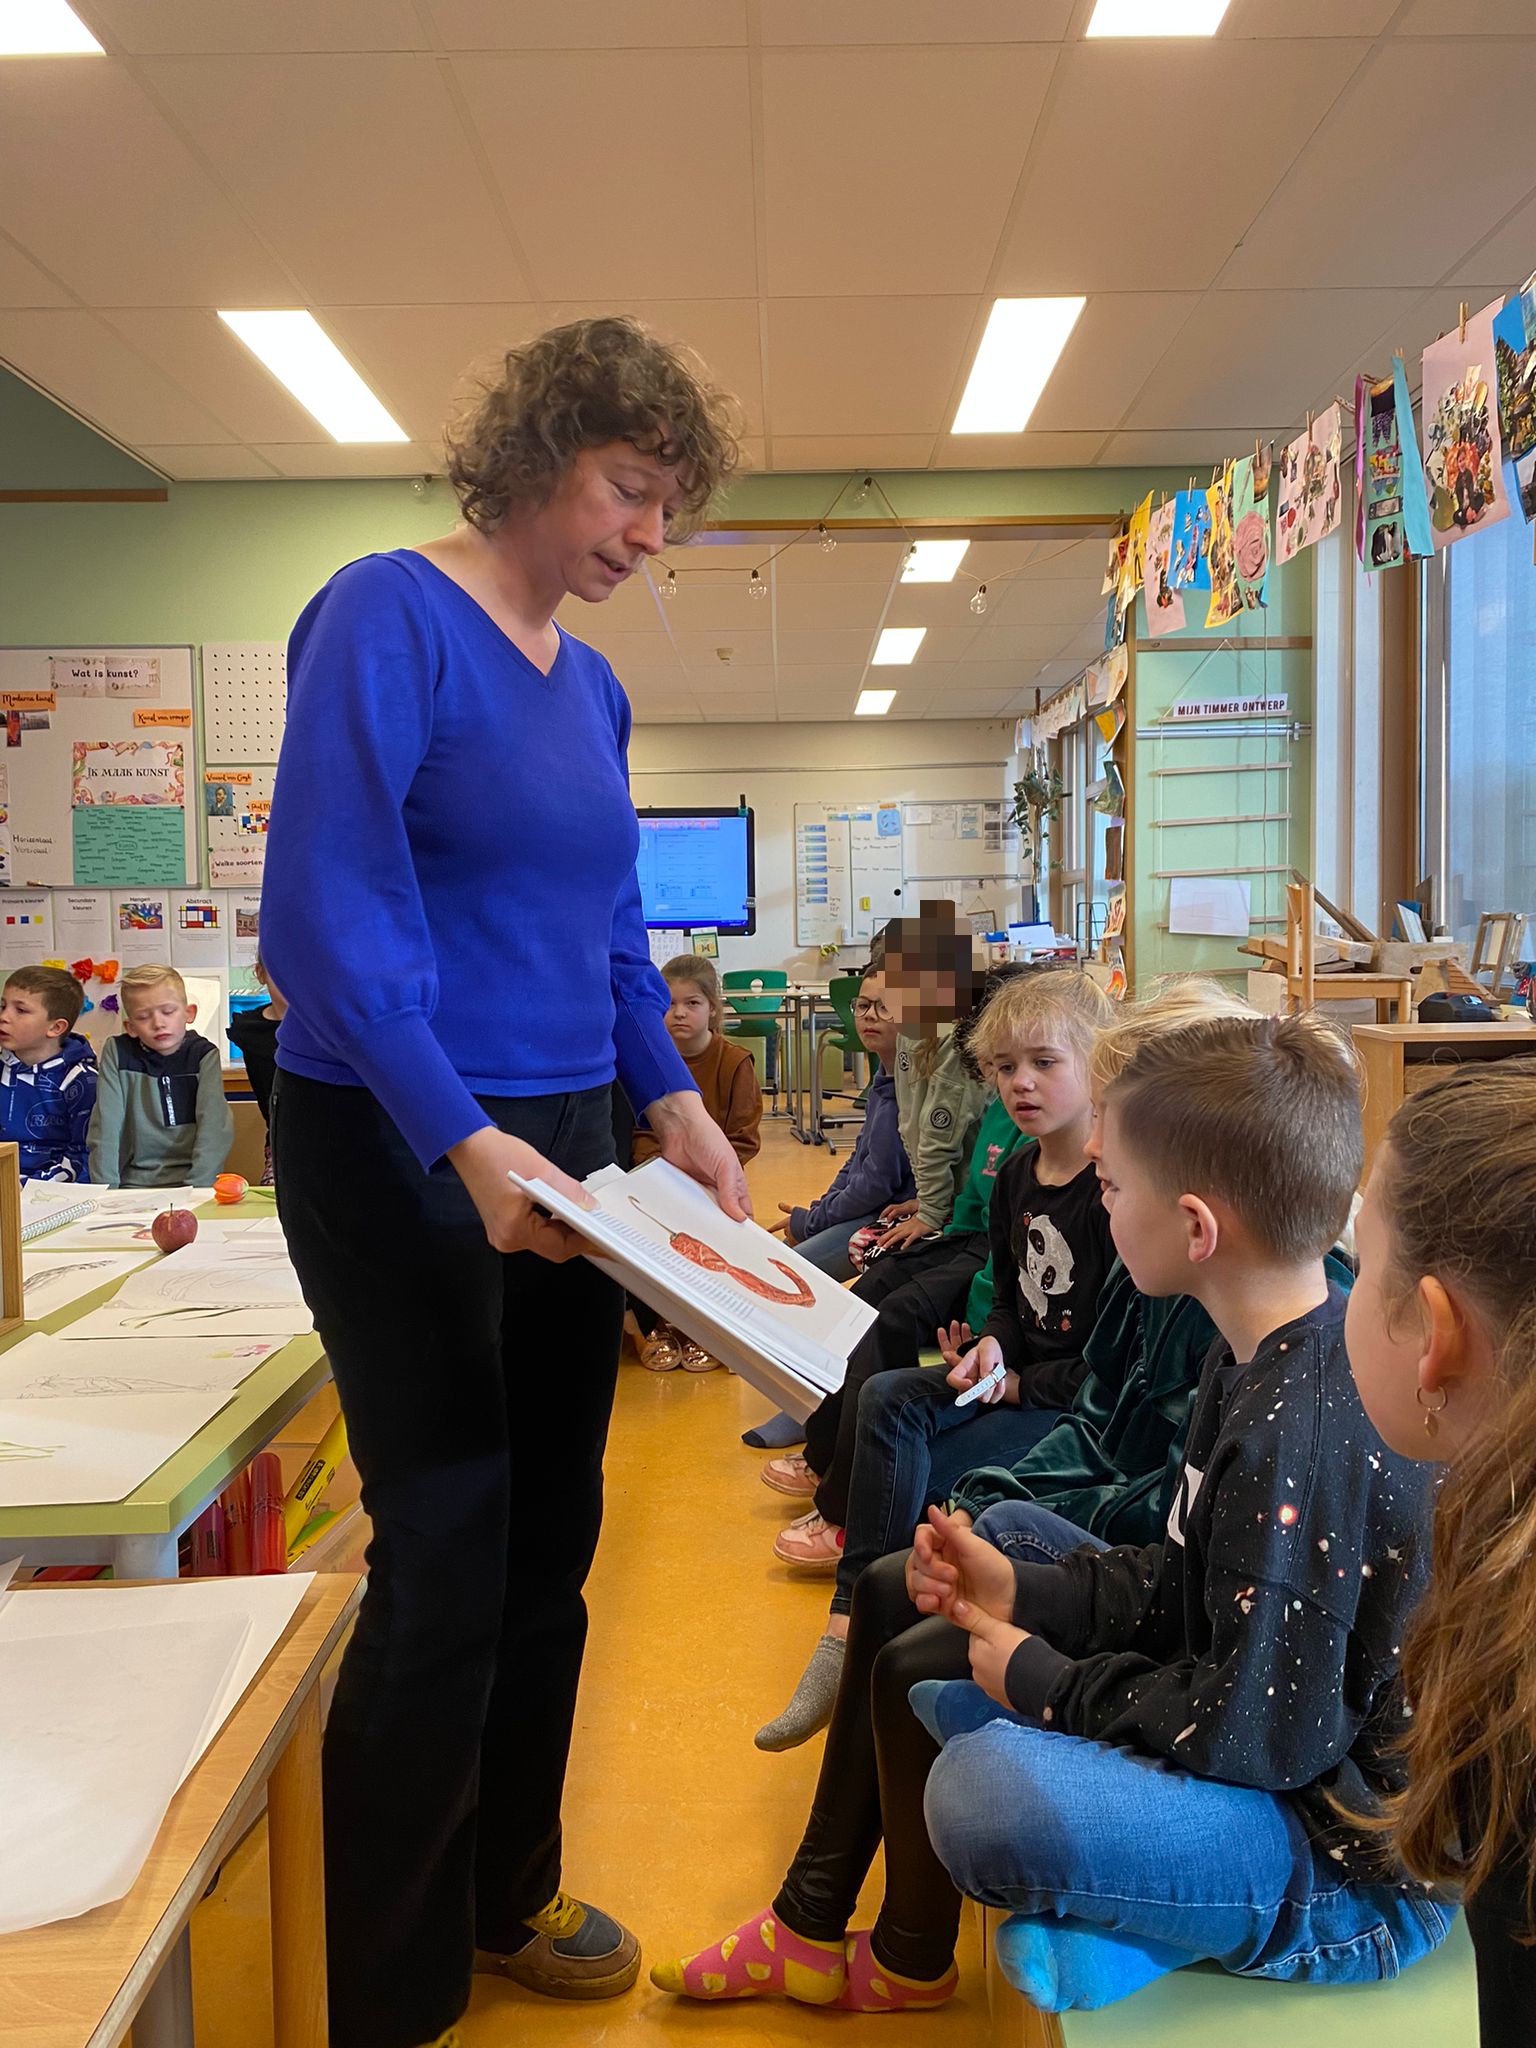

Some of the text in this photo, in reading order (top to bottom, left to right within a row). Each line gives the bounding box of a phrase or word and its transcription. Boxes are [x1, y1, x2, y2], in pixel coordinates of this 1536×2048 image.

[71, 669, 139, 678] Wat is kunst?
[1177, 699, 1285, 715] MIJN TIMMER ONTWERP
[87, 767, 169, 778] IK MAAK KUNST
